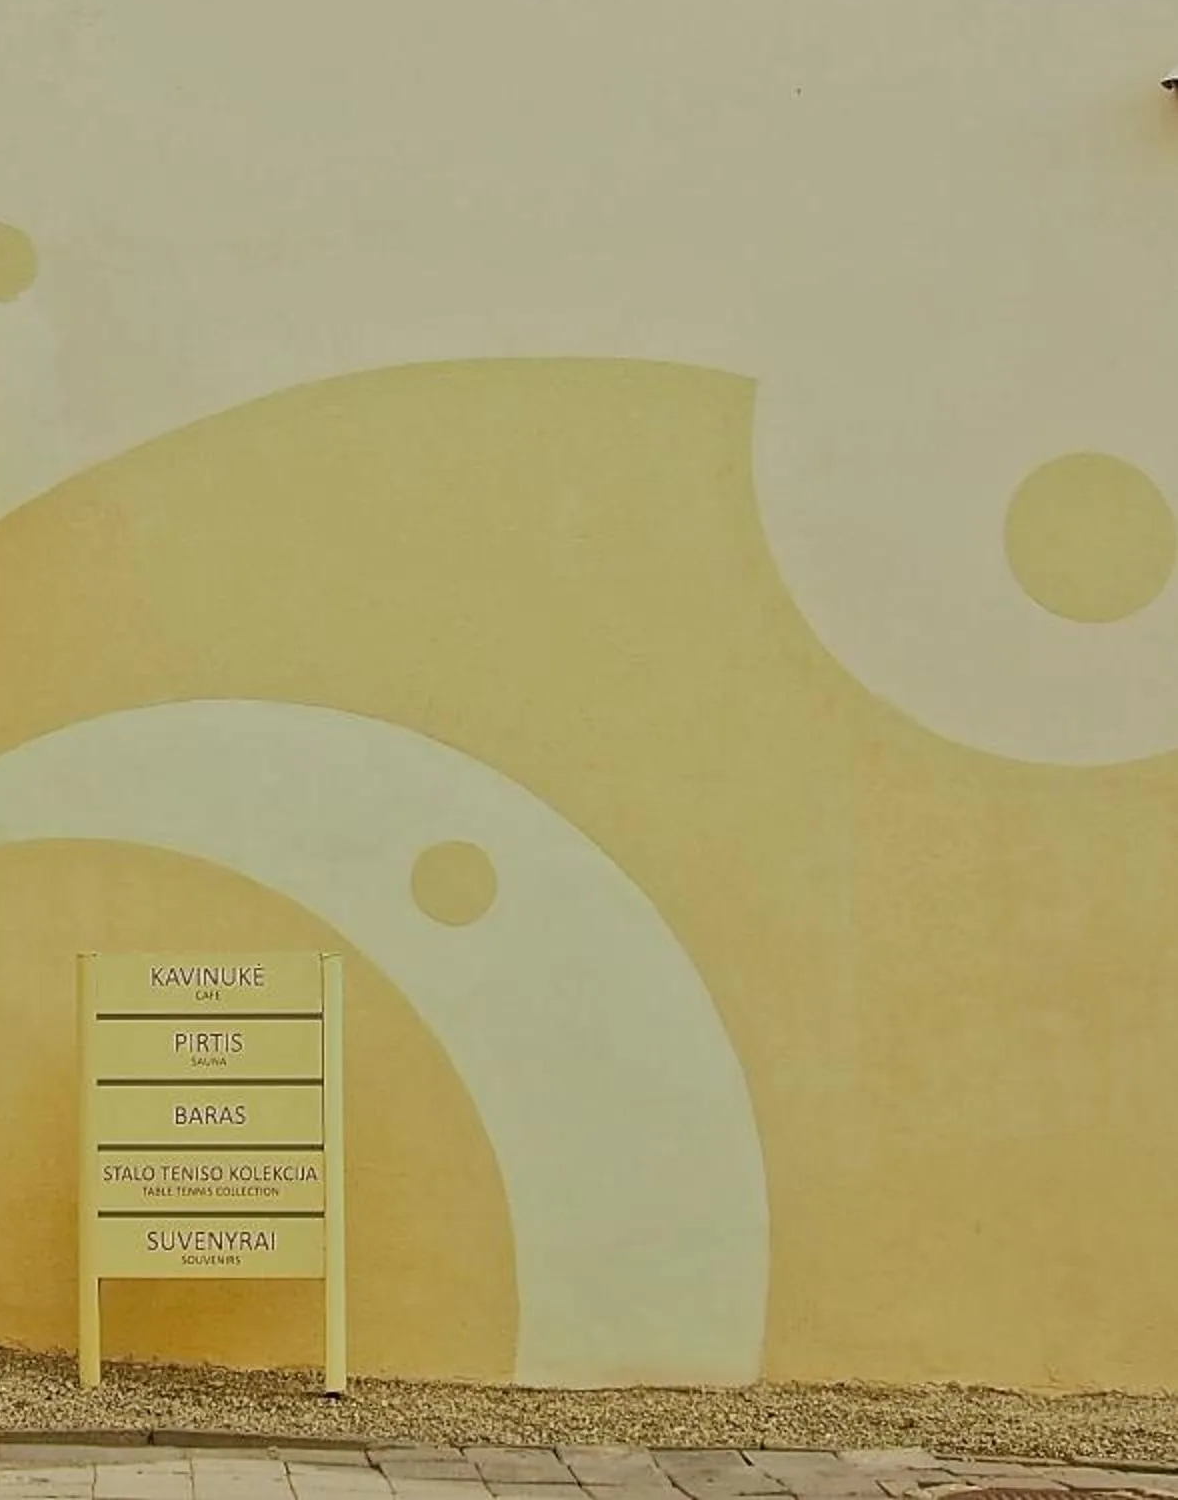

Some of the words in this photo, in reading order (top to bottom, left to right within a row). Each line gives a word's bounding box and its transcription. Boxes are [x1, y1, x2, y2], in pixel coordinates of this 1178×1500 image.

[150, 964, 265, 987] KAVINUKĖ
[195, 990, 222, 1001] CAFE
[175, 1033, 243, 1053] PIRTIS
[191, 1057, 227, 1067] SAUNA
[175, 1106, 247, 1126] BARAS
[103, 1166, 155, 1182] STALO
[163, 1166, 223, 1182] TENISO
[230, 1166, 318, 1182] KOLEKCIJA
[143, 1187, 172, 1198] TABLE
[216, 1187, 279, 1198] COLLECTION
[147, 1232, 276, 1252] SUVENYRAI
[182, 1255, 241, 1266] SOUVENIRS
